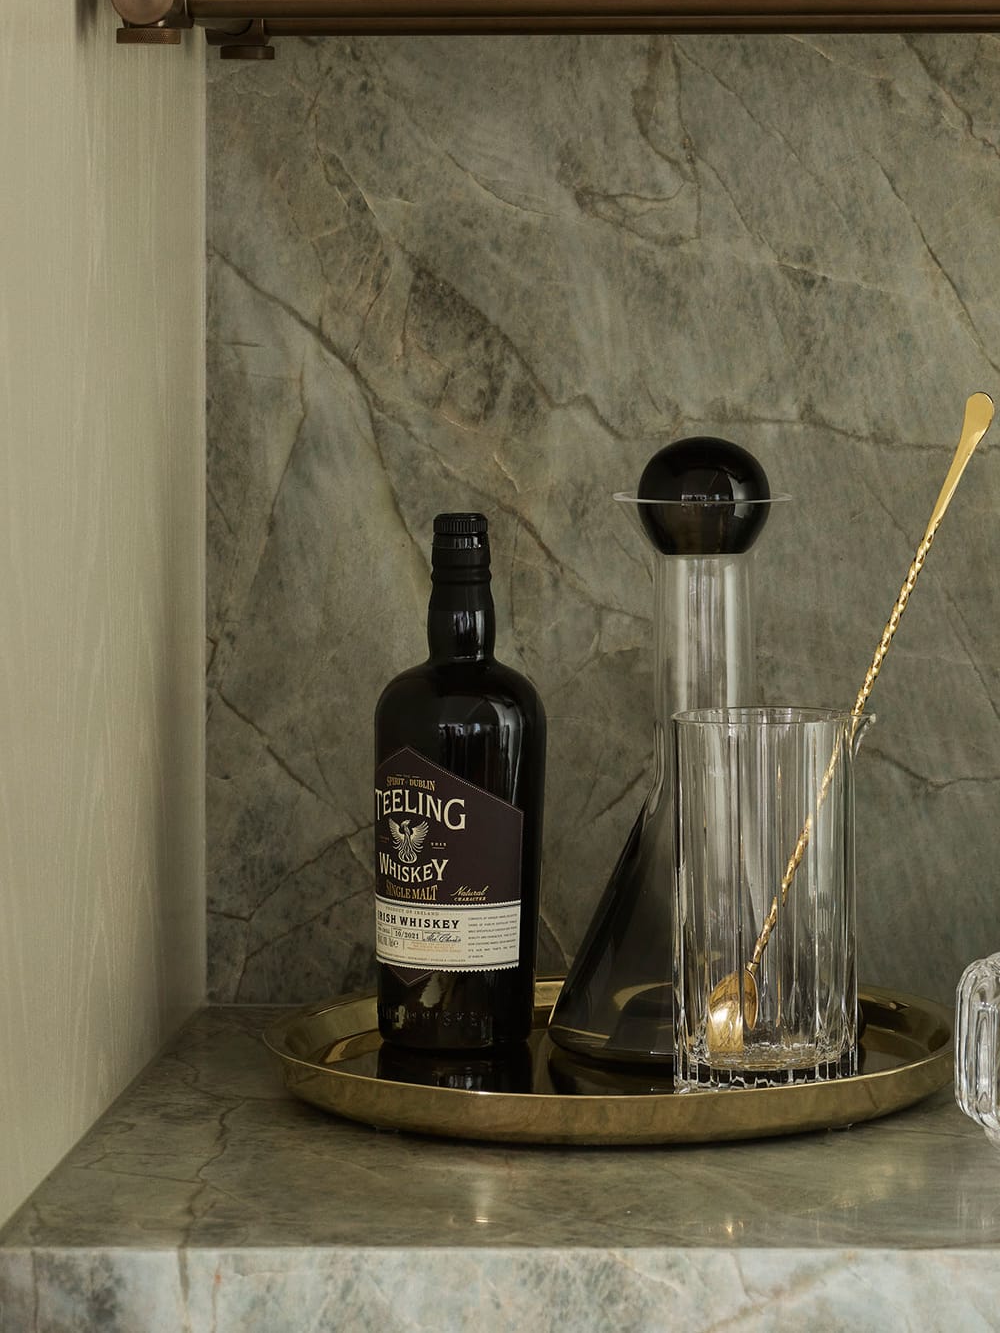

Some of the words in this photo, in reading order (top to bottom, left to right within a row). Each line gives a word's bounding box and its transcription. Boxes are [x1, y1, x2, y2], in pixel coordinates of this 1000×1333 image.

[409, 778, 436, 792] DUBLIN
[375, 788, 466, 831] TEELING
[379, 851, 449, 883] WHISKEY
[386, 879, 412, 900] SINGLE
[412, 884, 438, 901] MALT
[450, 885, 489, 897] Natural
[377, 910, 397, 924] IRISH
[400, 915, 460, 929] WHISKEY
[395, 930, 419, 940] 10/2021
